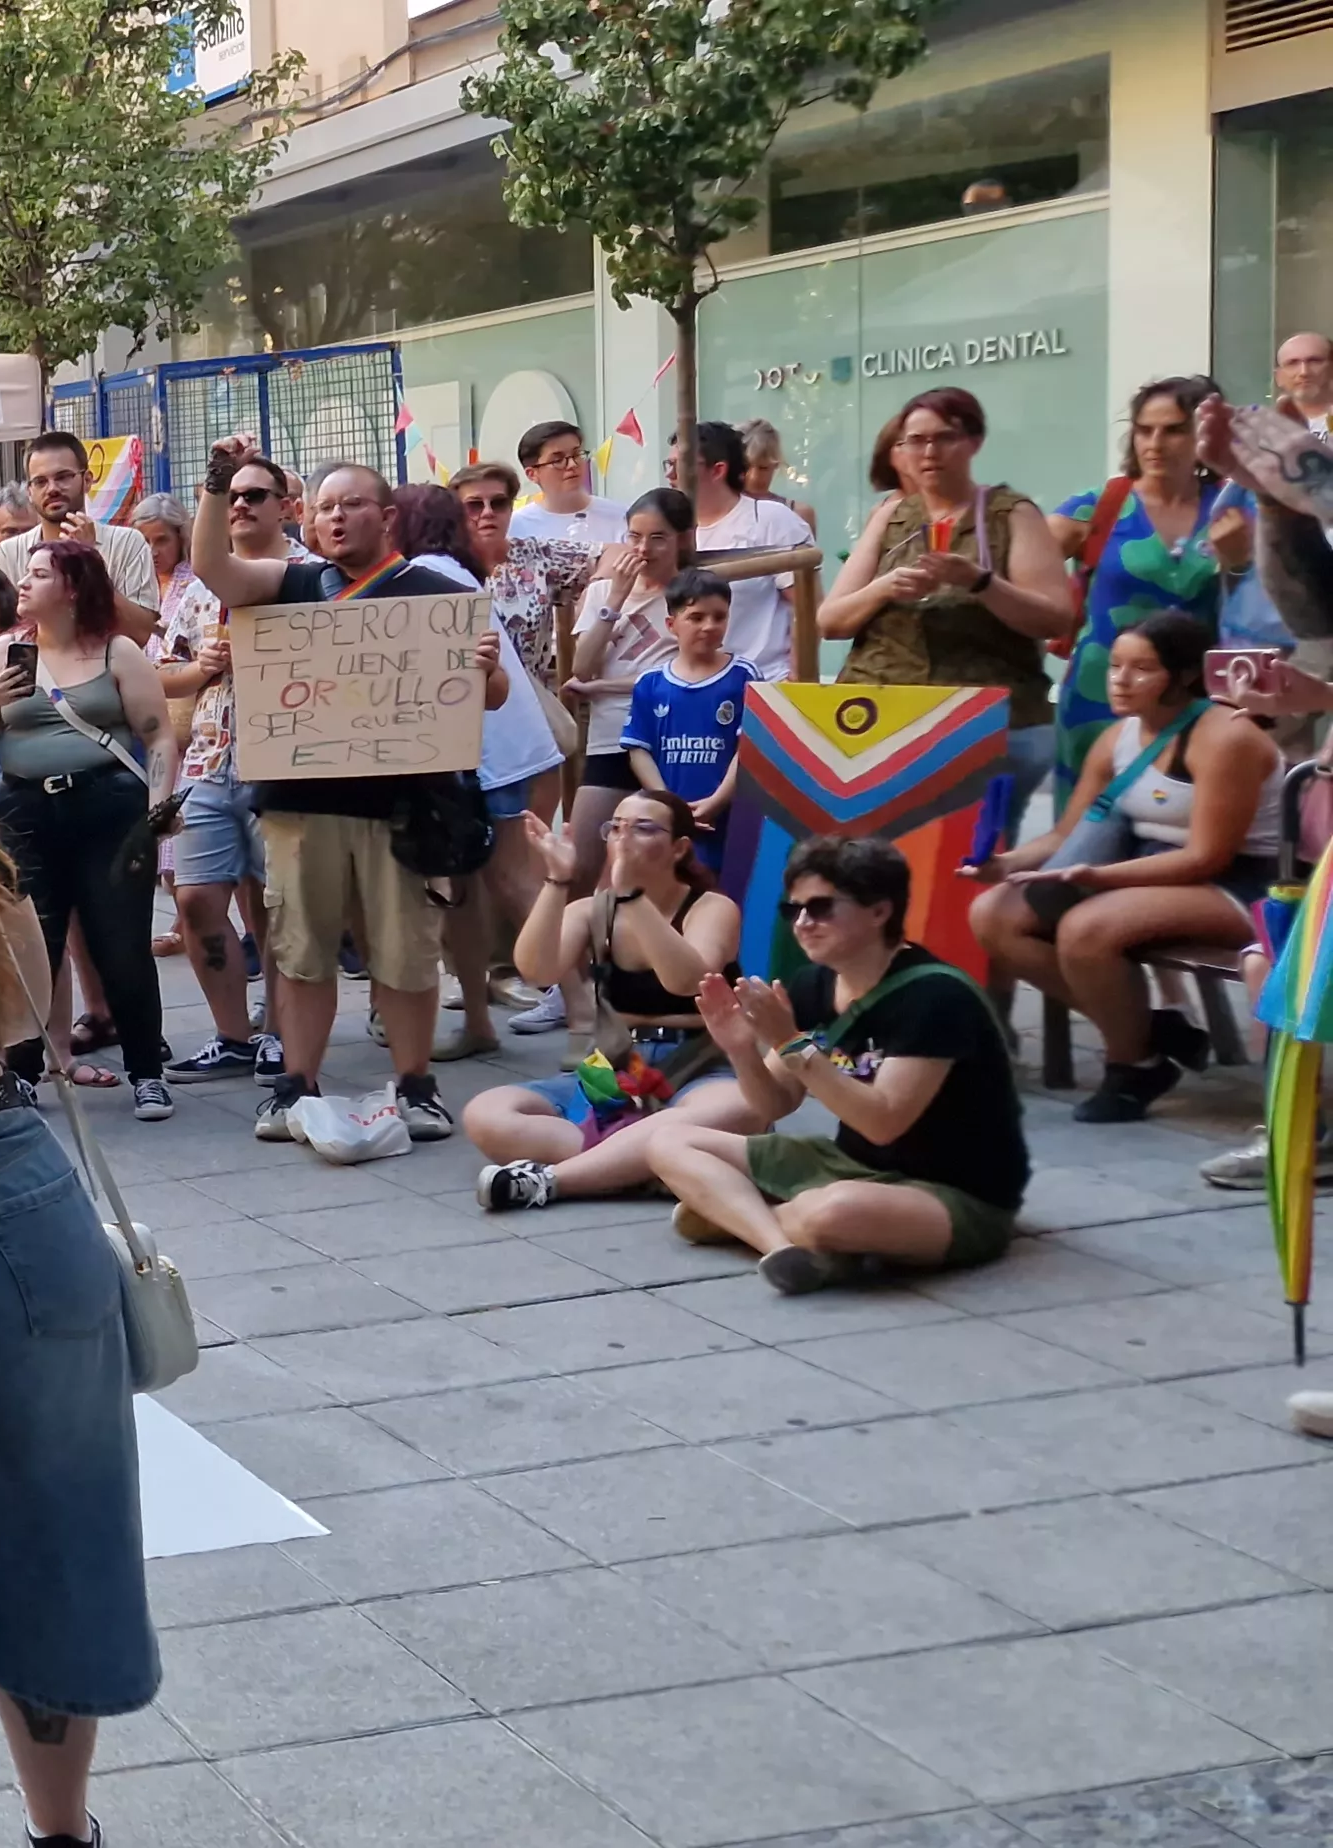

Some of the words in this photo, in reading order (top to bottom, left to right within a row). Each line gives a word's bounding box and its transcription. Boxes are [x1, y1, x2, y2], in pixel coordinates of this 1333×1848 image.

[861, 342, 957, 377] CLINICA
[965, 328, 1067, 366] DENTAL
[253, 600, 411, 652] ESPERO
[429, 597, 491, 638] QUE
[239, 658, 312, 682] TE
[447, 649, 481, 671] DE
[280, 676, 473, 709] ORGULLO
[248, 710, 323, 746] SER
[661, 733, 726, 751] Emirates
[291, 733, 441, 767] ERES
[679, 750, 718, 764] BETTER
